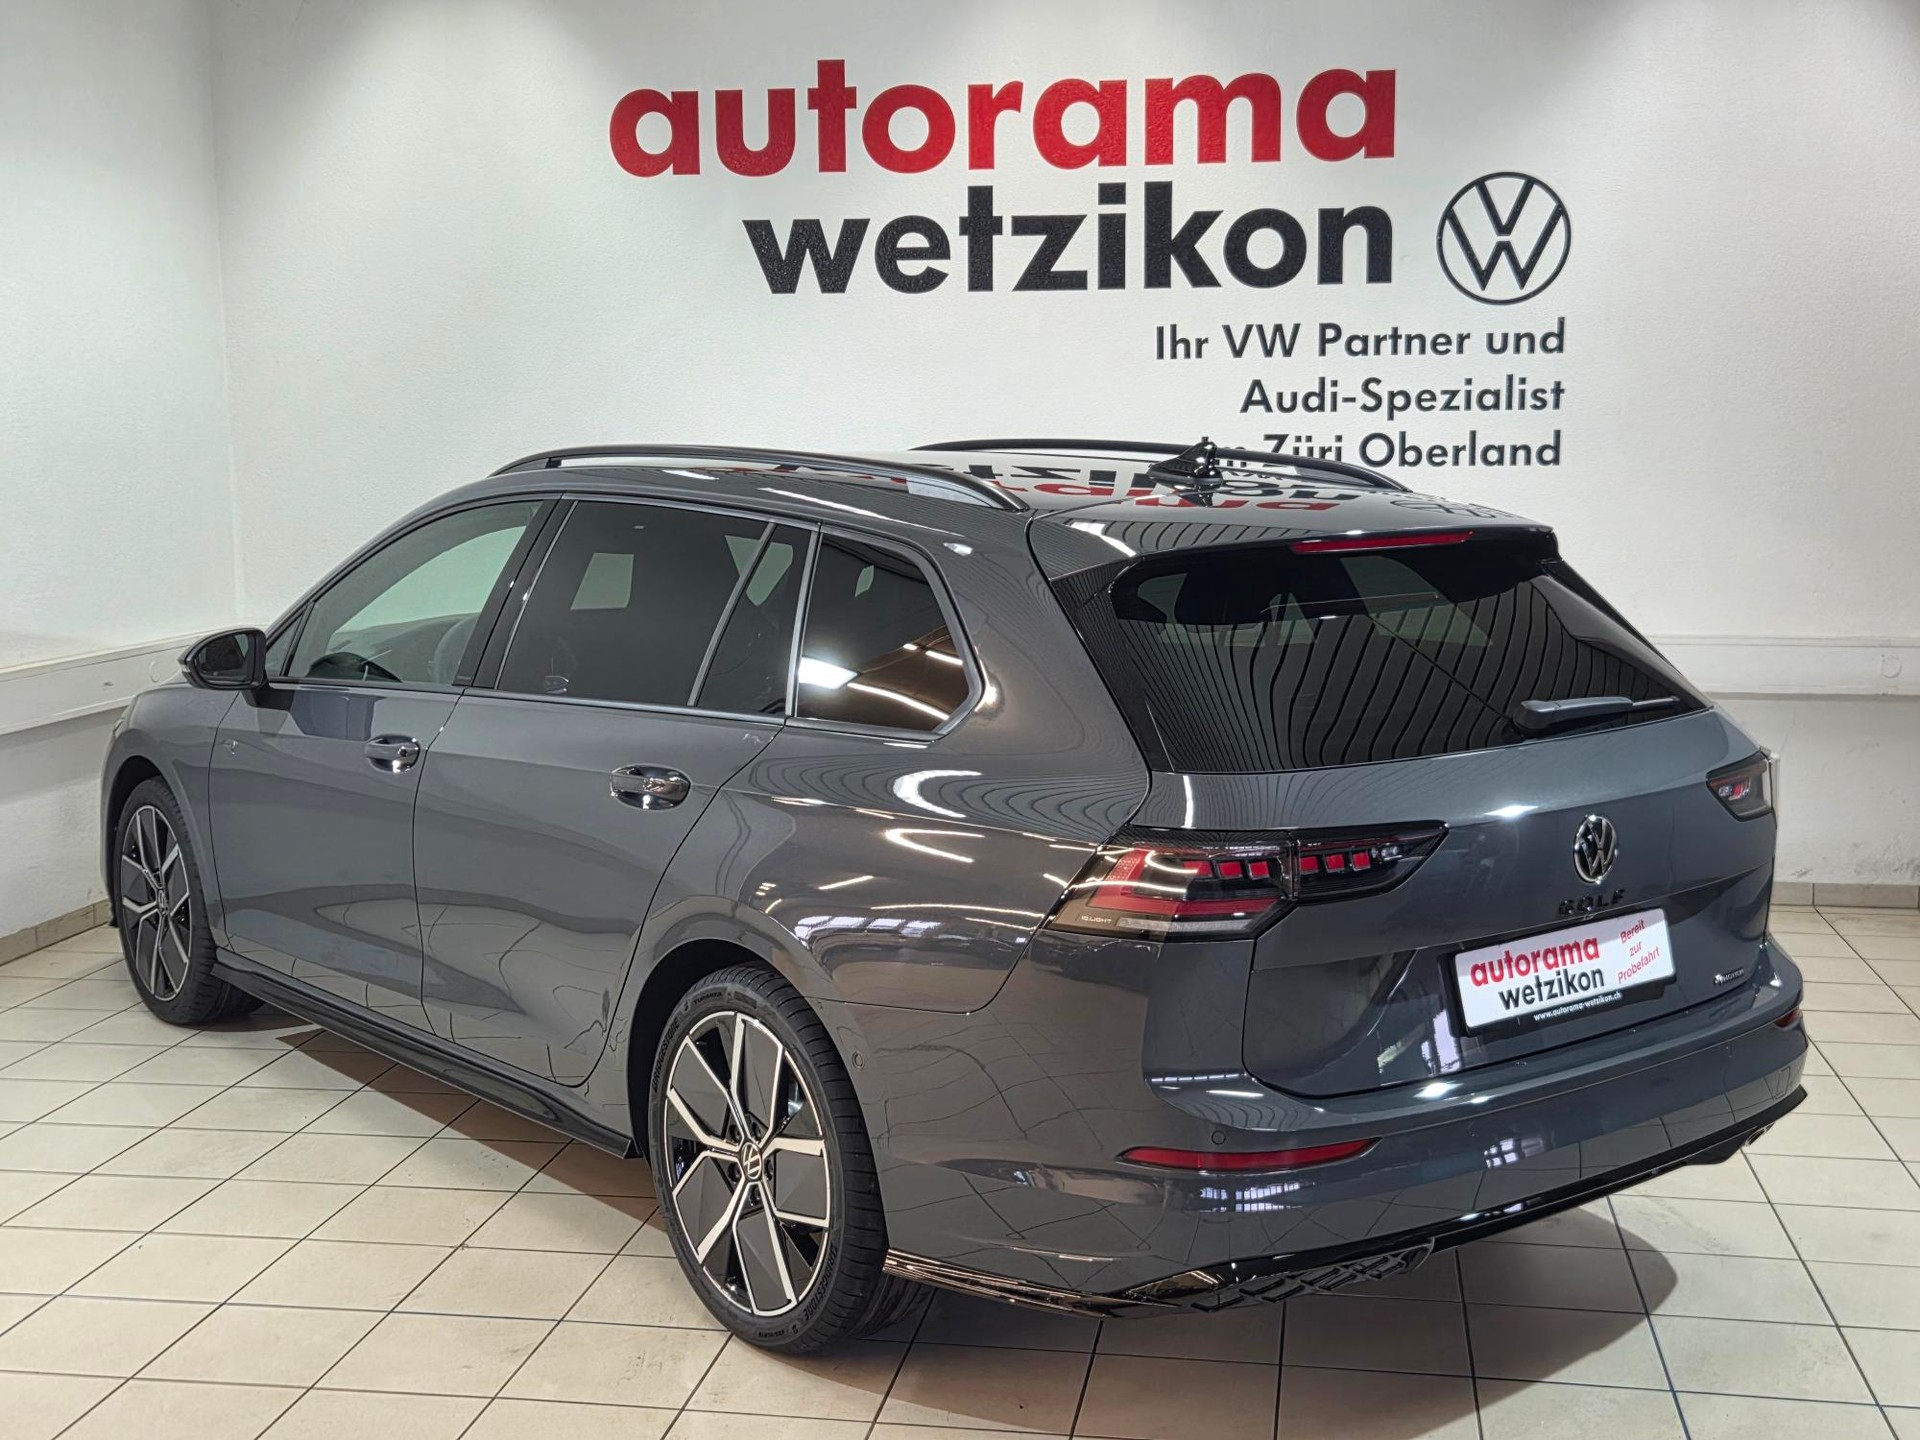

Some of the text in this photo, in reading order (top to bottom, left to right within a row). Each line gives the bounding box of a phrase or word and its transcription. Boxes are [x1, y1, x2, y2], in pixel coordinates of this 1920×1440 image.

[610, 60, 1396, 178] autorama
[742, 181, 1393, 295] wetzikon
[1156, 317, 1565, 360] Ihr VW Partner und
[1240, 374, 1565, 421] Audi-Spezialist
[1358, 429, 1561, 468] Oberland
[1558, 888, 1625, 915] GOLF
[1620, 919, 1646, 944] Bereit
[1629, 941, 1643, 957] zur
[1470, 937, 1600, 988] autorama
[1617, 946, 1660, 984] Probefahrt
[1498, 967, 1605, 1011] wetzikon
[1533, 992, 1622, 1022] www.autorama-wetzikon.ch
